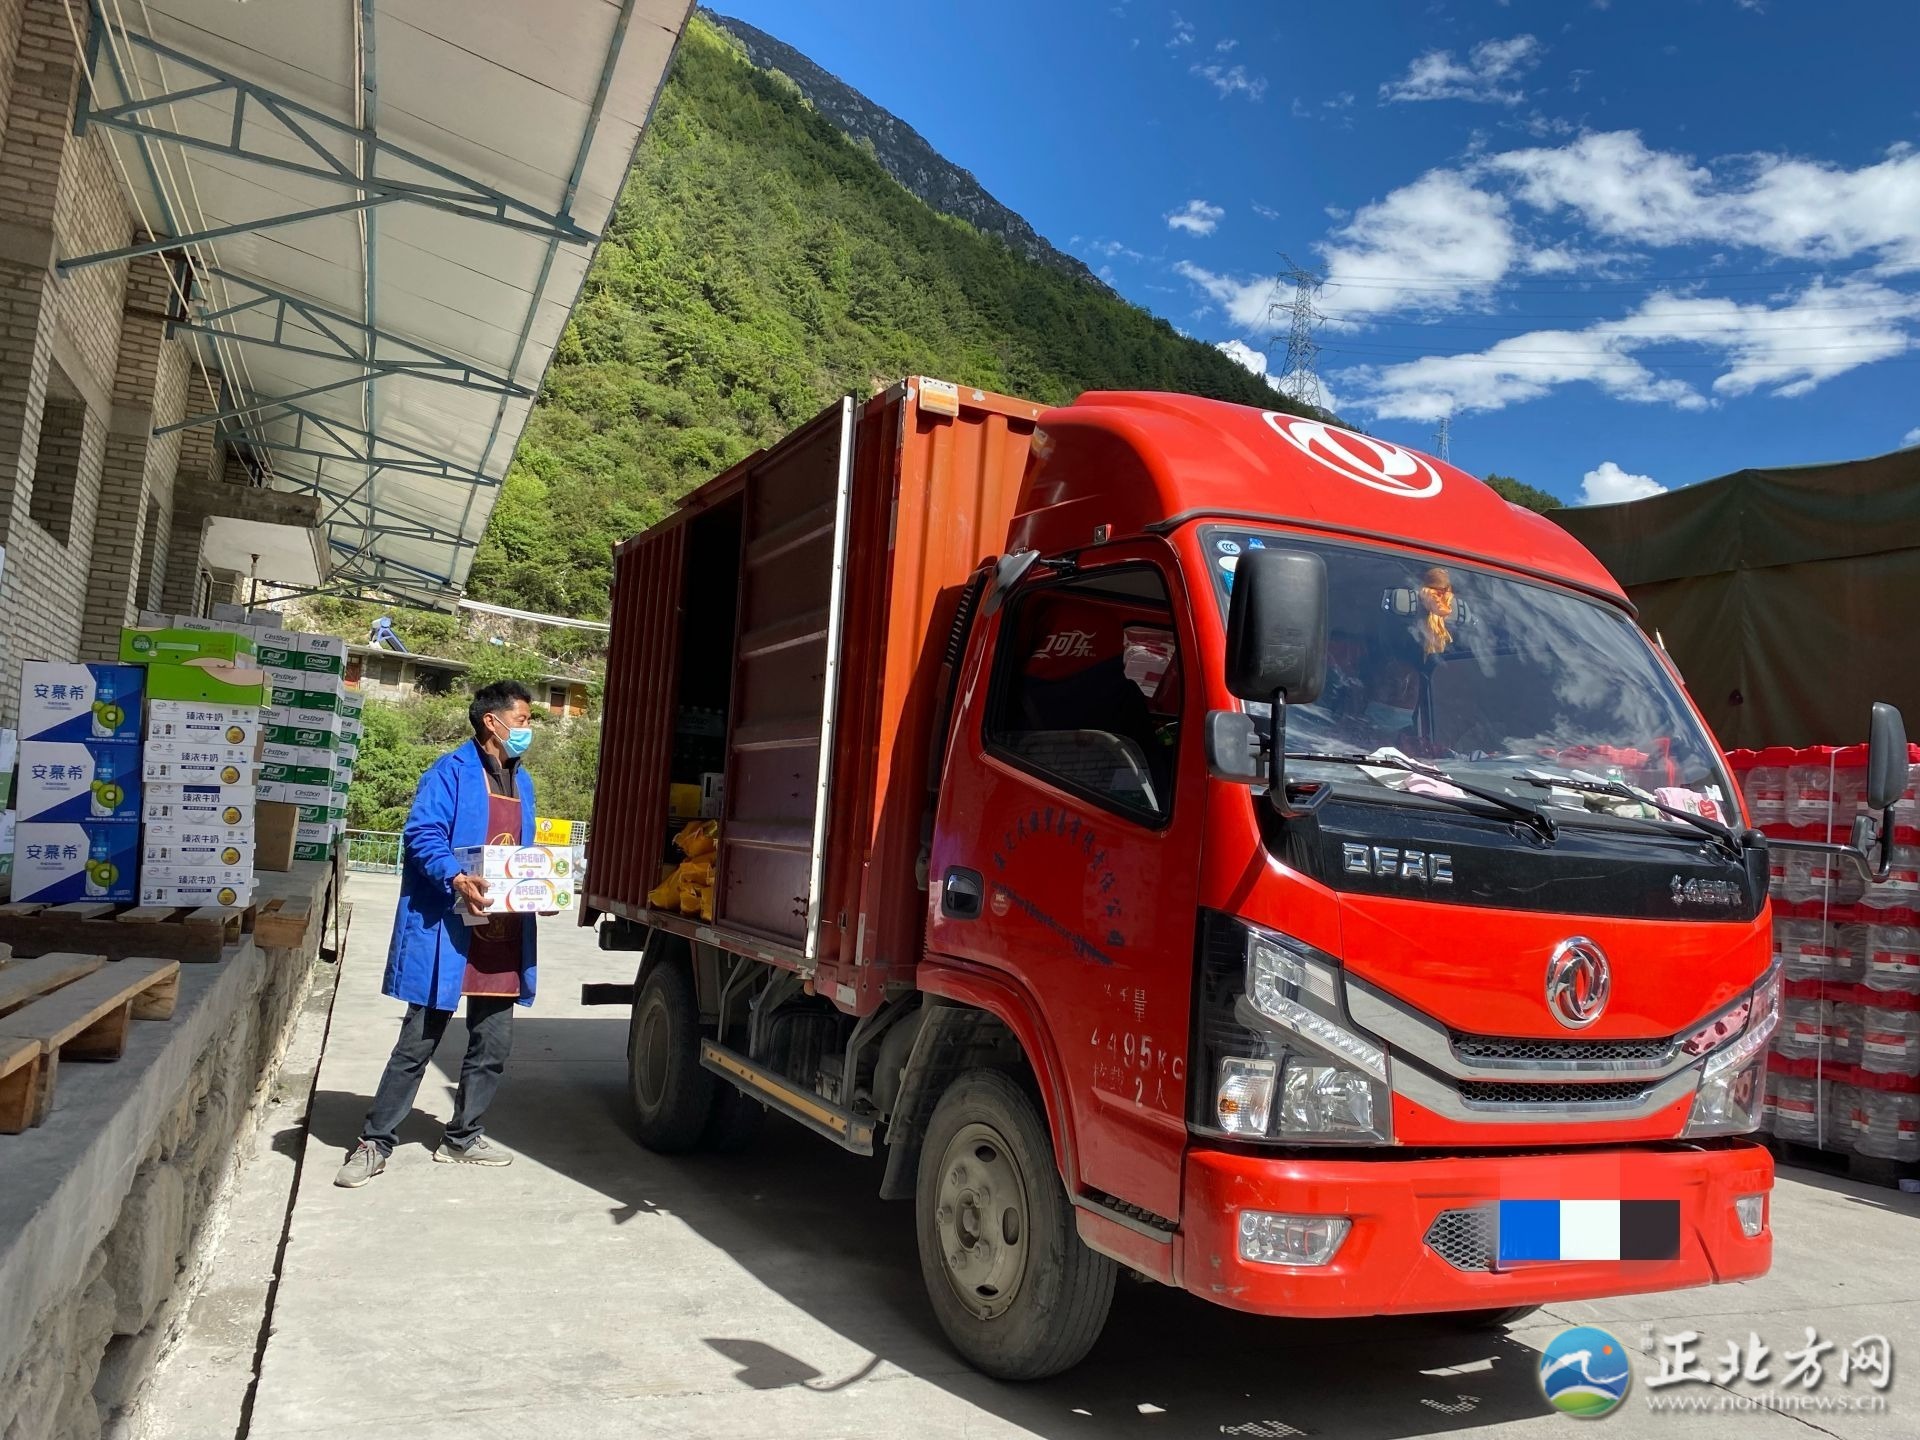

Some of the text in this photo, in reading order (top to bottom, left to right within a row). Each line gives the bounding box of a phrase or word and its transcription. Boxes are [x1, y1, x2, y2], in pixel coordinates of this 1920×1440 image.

[34, 684, 84, 700] 安慕希
[186, 711, 223, 721] 臻浓牛奶
[181, 752, 218, 762] 臻浓牛奶
[32, 764, 82, 780] 安慕希
[182, 793, 219, 803] 臻浓牛奶
[182, 834, 219, 844] 臻浓牛奶
[26, 844, 77, 860] 安慕希
[1341, 842, 1454, 884] DFAC
[178, 876, 216, 885] 臻浓牛奶
